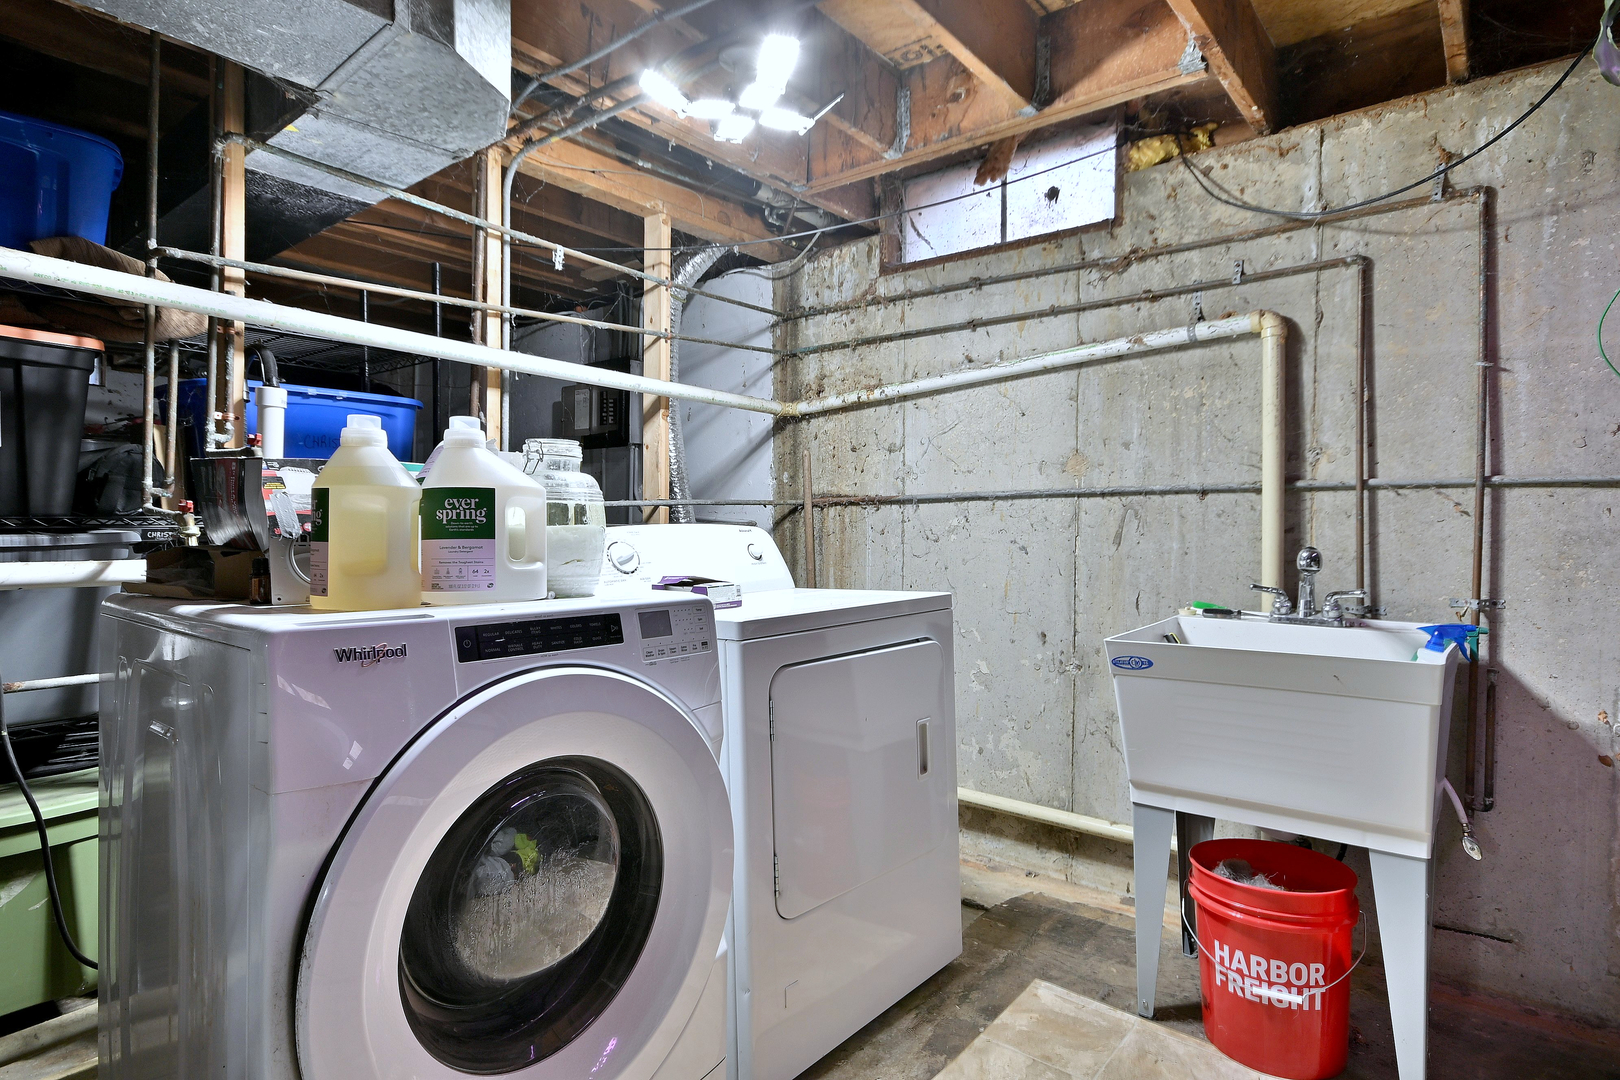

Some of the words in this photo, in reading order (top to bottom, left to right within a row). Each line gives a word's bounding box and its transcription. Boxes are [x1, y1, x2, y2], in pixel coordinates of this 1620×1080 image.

[444, 498, 480, 509] ever
[436, 507, 487, 524] spring
[333, 643, 407, 664] Whirlpool
[1214, 939, 1325, 986] HARBOR
[1215, 963, 1326, 1011] FREIGHT
